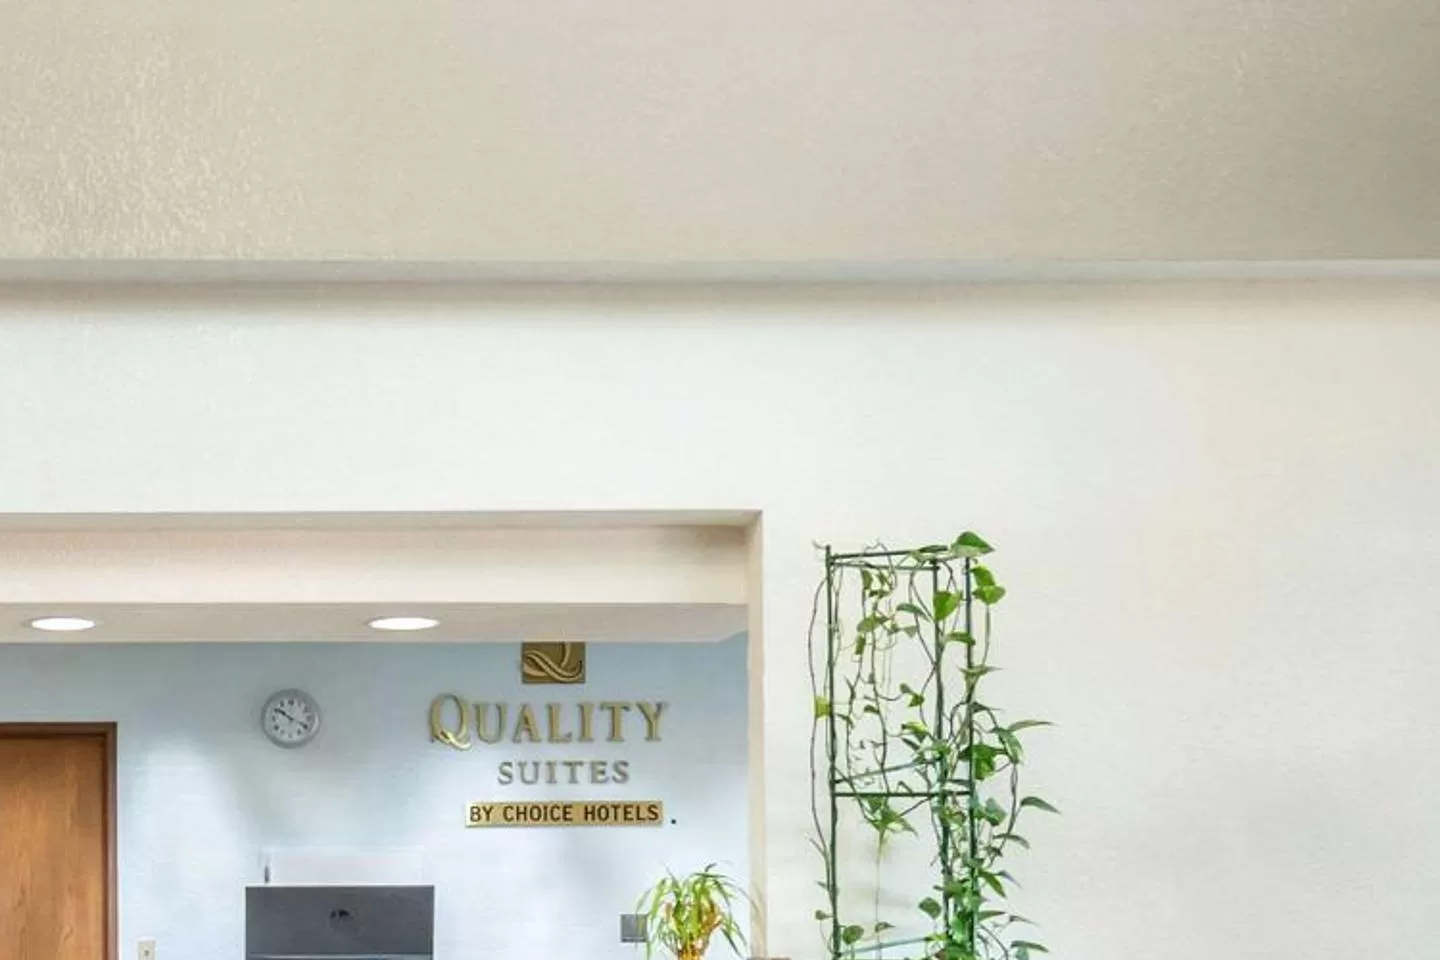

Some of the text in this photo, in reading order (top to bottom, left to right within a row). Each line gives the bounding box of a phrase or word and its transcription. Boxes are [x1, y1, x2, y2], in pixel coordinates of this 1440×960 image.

[428, 693, 667, 751] QUALITY
[497, 761, 630, 785] SUITES
[469, 803, 660, 824] BY CHOICE HOTELS
